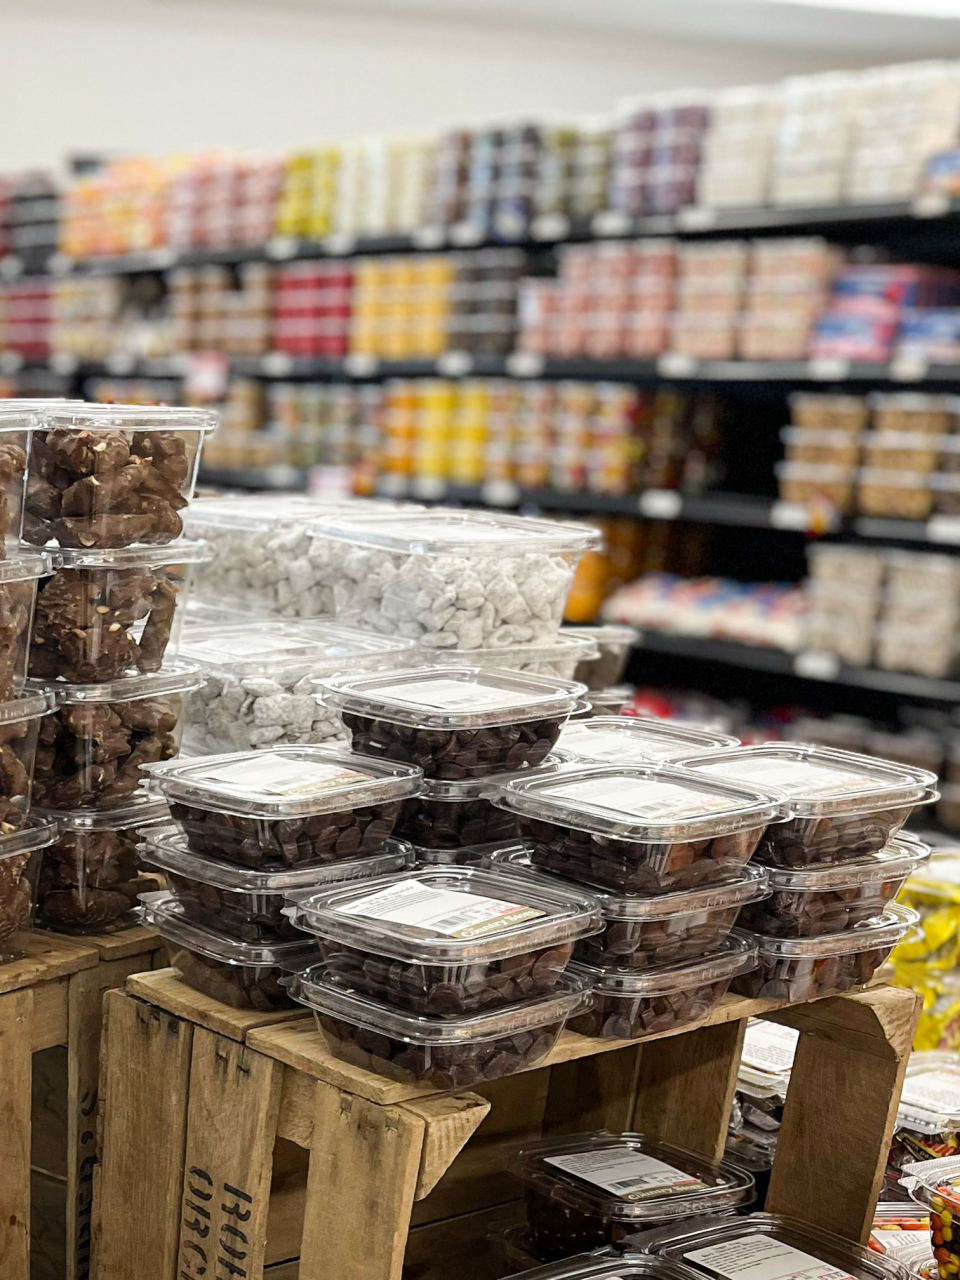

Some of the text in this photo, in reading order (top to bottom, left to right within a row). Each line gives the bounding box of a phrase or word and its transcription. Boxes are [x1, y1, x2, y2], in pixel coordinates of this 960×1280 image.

[461, 908, 539, 939] Country Store
[627, 1182, 703, 1200] Country Store
